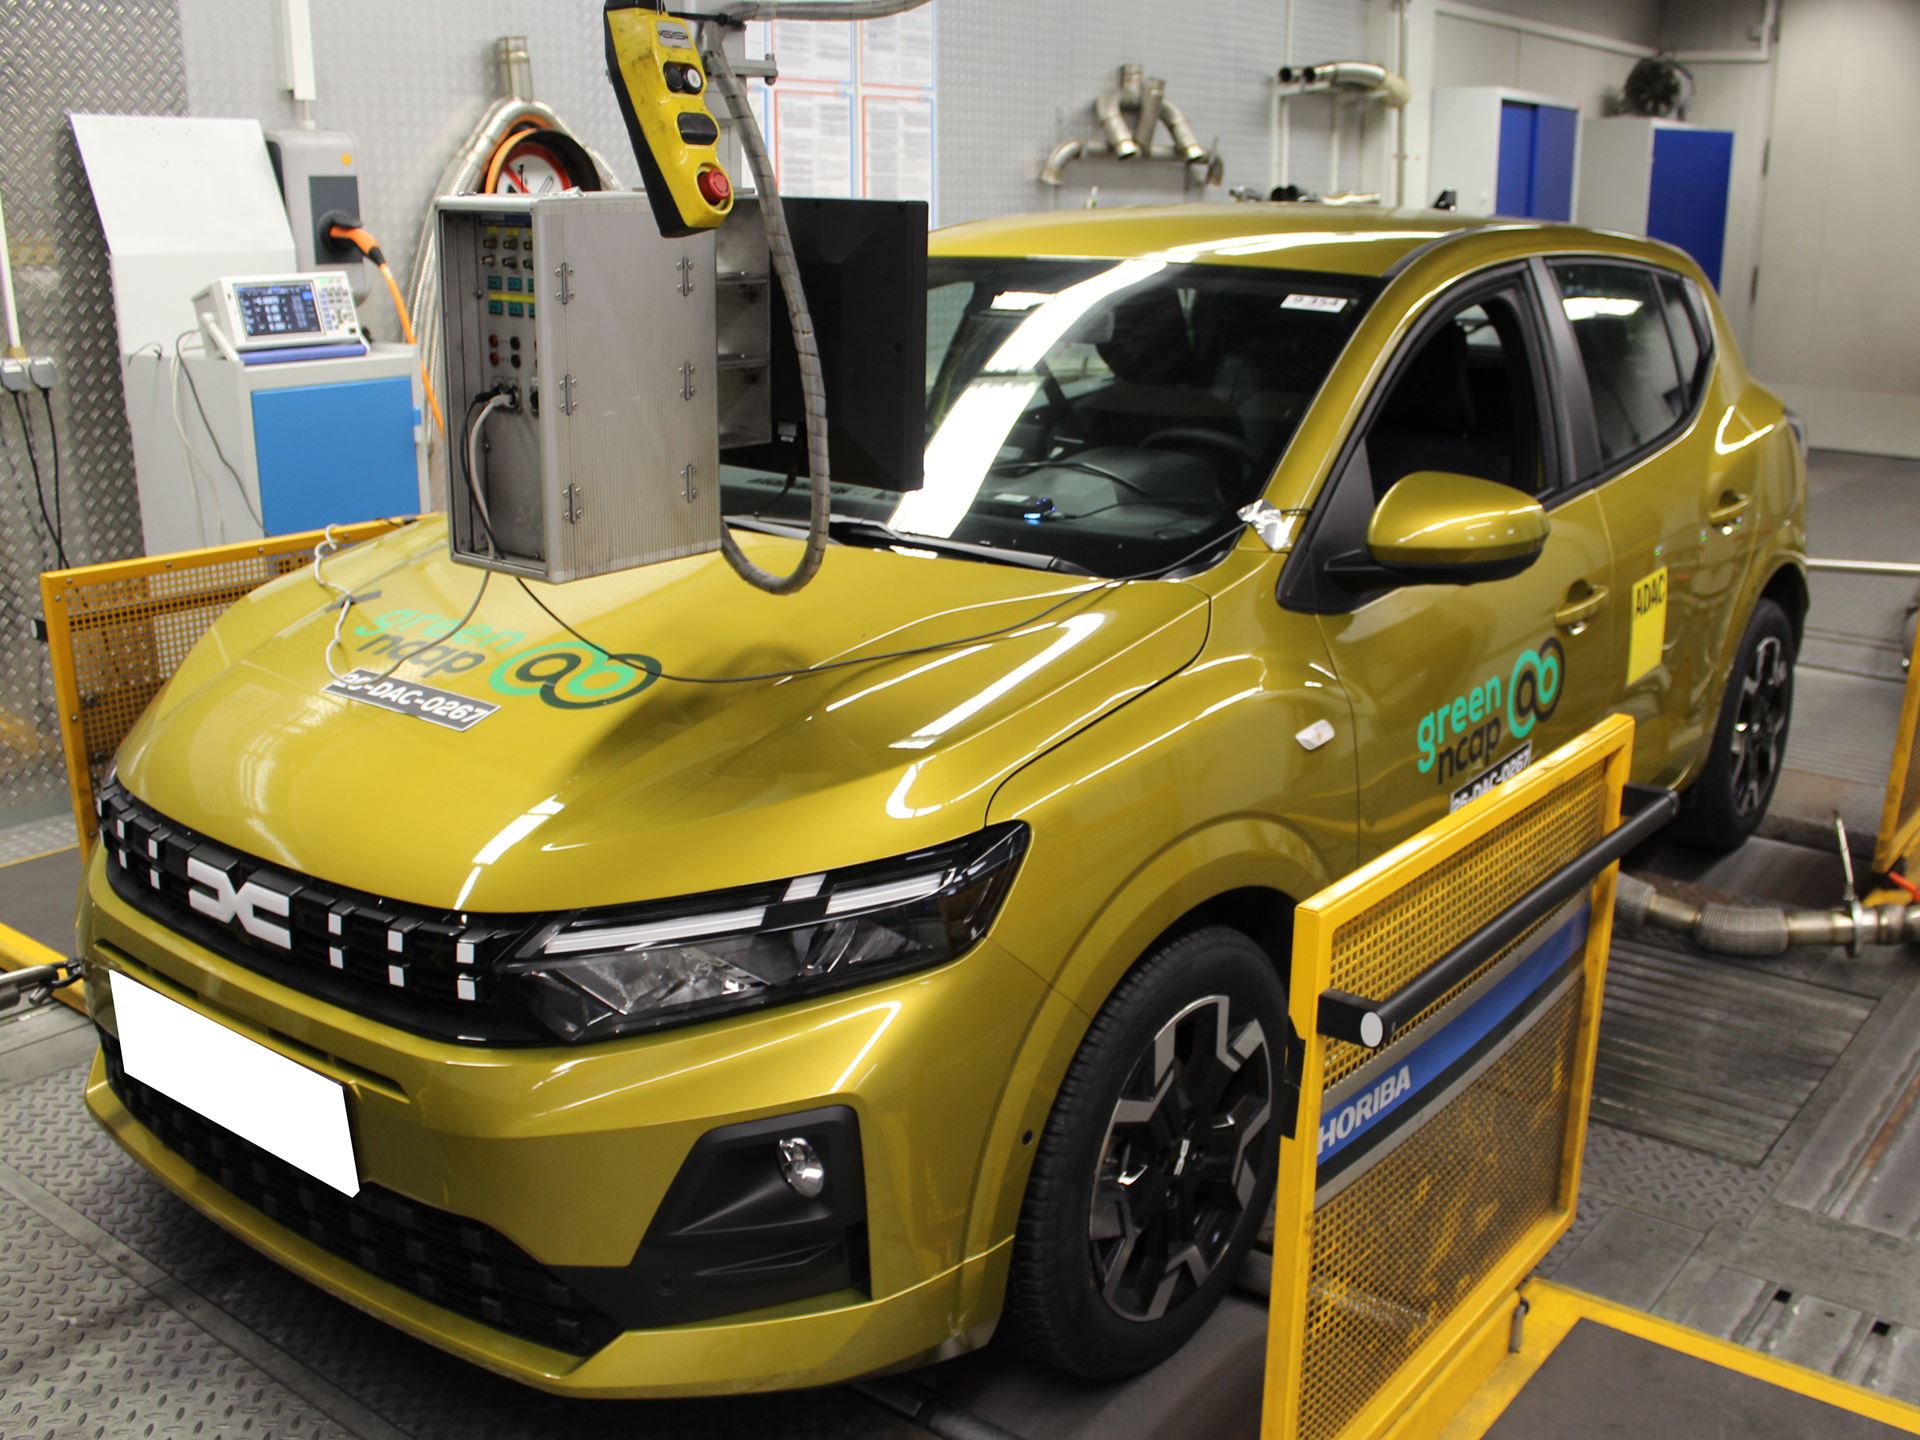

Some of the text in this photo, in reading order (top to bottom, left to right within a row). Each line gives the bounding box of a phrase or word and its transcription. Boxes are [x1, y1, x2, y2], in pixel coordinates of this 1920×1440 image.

[1636, 574, 1666, 614] ADAC
[354, 608, 526, 653] green
[356, 634, 486, 679] ncap
[1417, 675, 1502, 774] green
[1437, 717, 1502, 785] ncap
[1317, 1065, 1412, 1155] HORIBA
